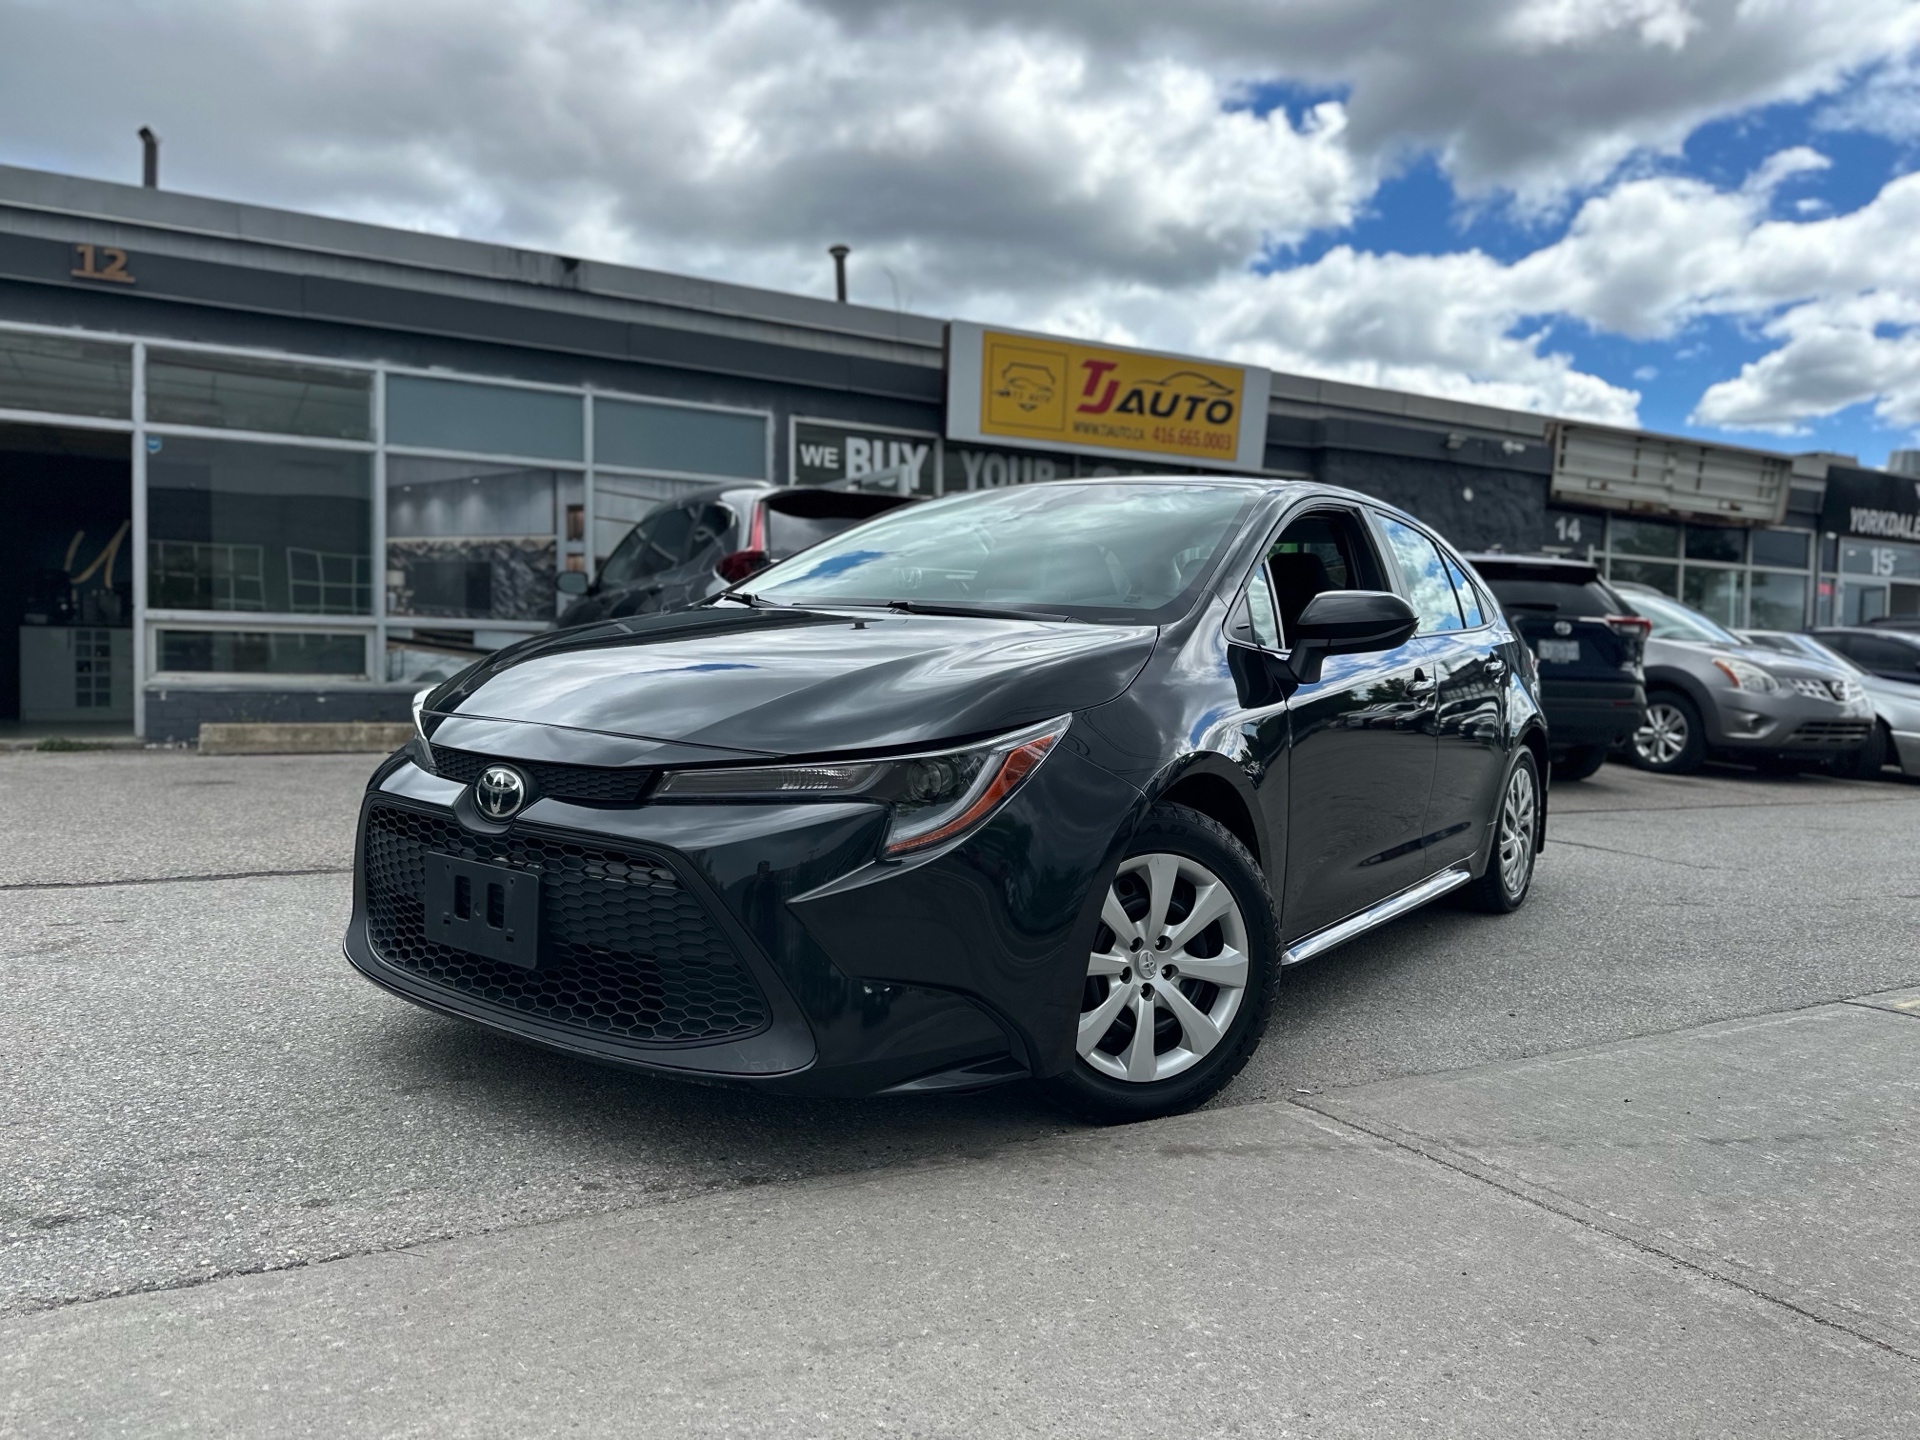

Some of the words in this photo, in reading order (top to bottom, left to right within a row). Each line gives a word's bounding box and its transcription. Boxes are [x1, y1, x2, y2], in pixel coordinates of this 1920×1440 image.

[75, 243, 128, 278] 12
[799, 443, 839, 470] WE
[845, 436, 930, 489] BUY
[1555, 516, 1581, 543] 14
[1870, 547, 1895, 576] 15
